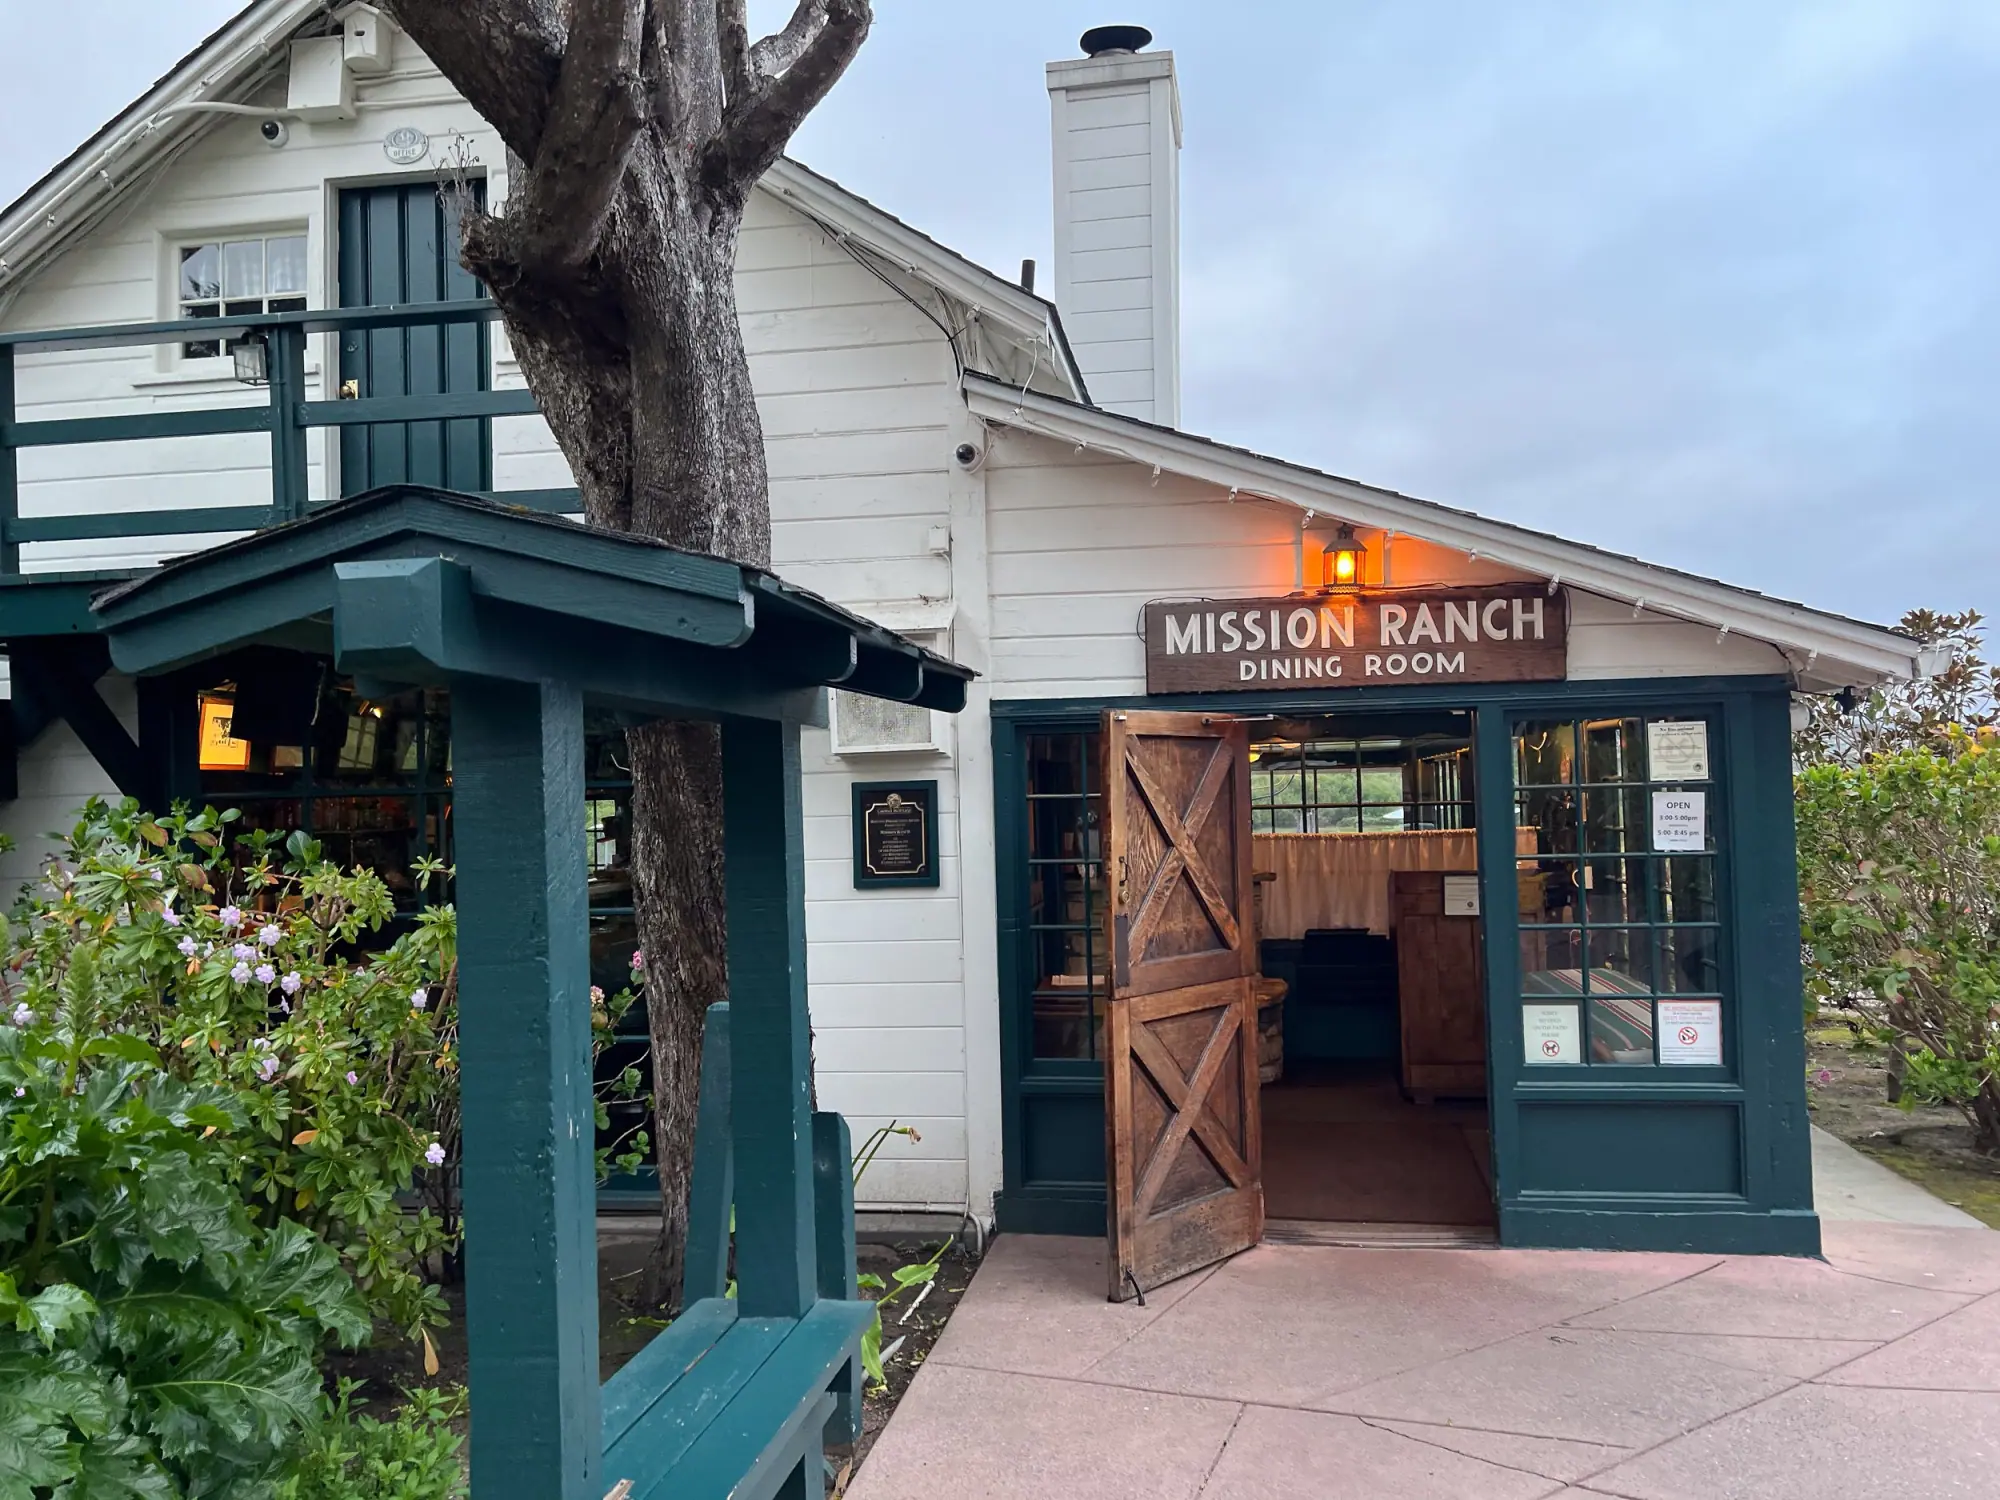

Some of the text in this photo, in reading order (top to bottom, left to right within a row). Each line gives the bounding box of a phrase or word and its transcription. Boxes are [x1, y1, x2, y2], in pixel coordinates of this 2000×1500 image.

[1165, 598, 1545, 656] MISSION RANCH
[1239, 651, 1466, 681] DINING ROOM
[1666, 801, 1691, 809] OPEN
